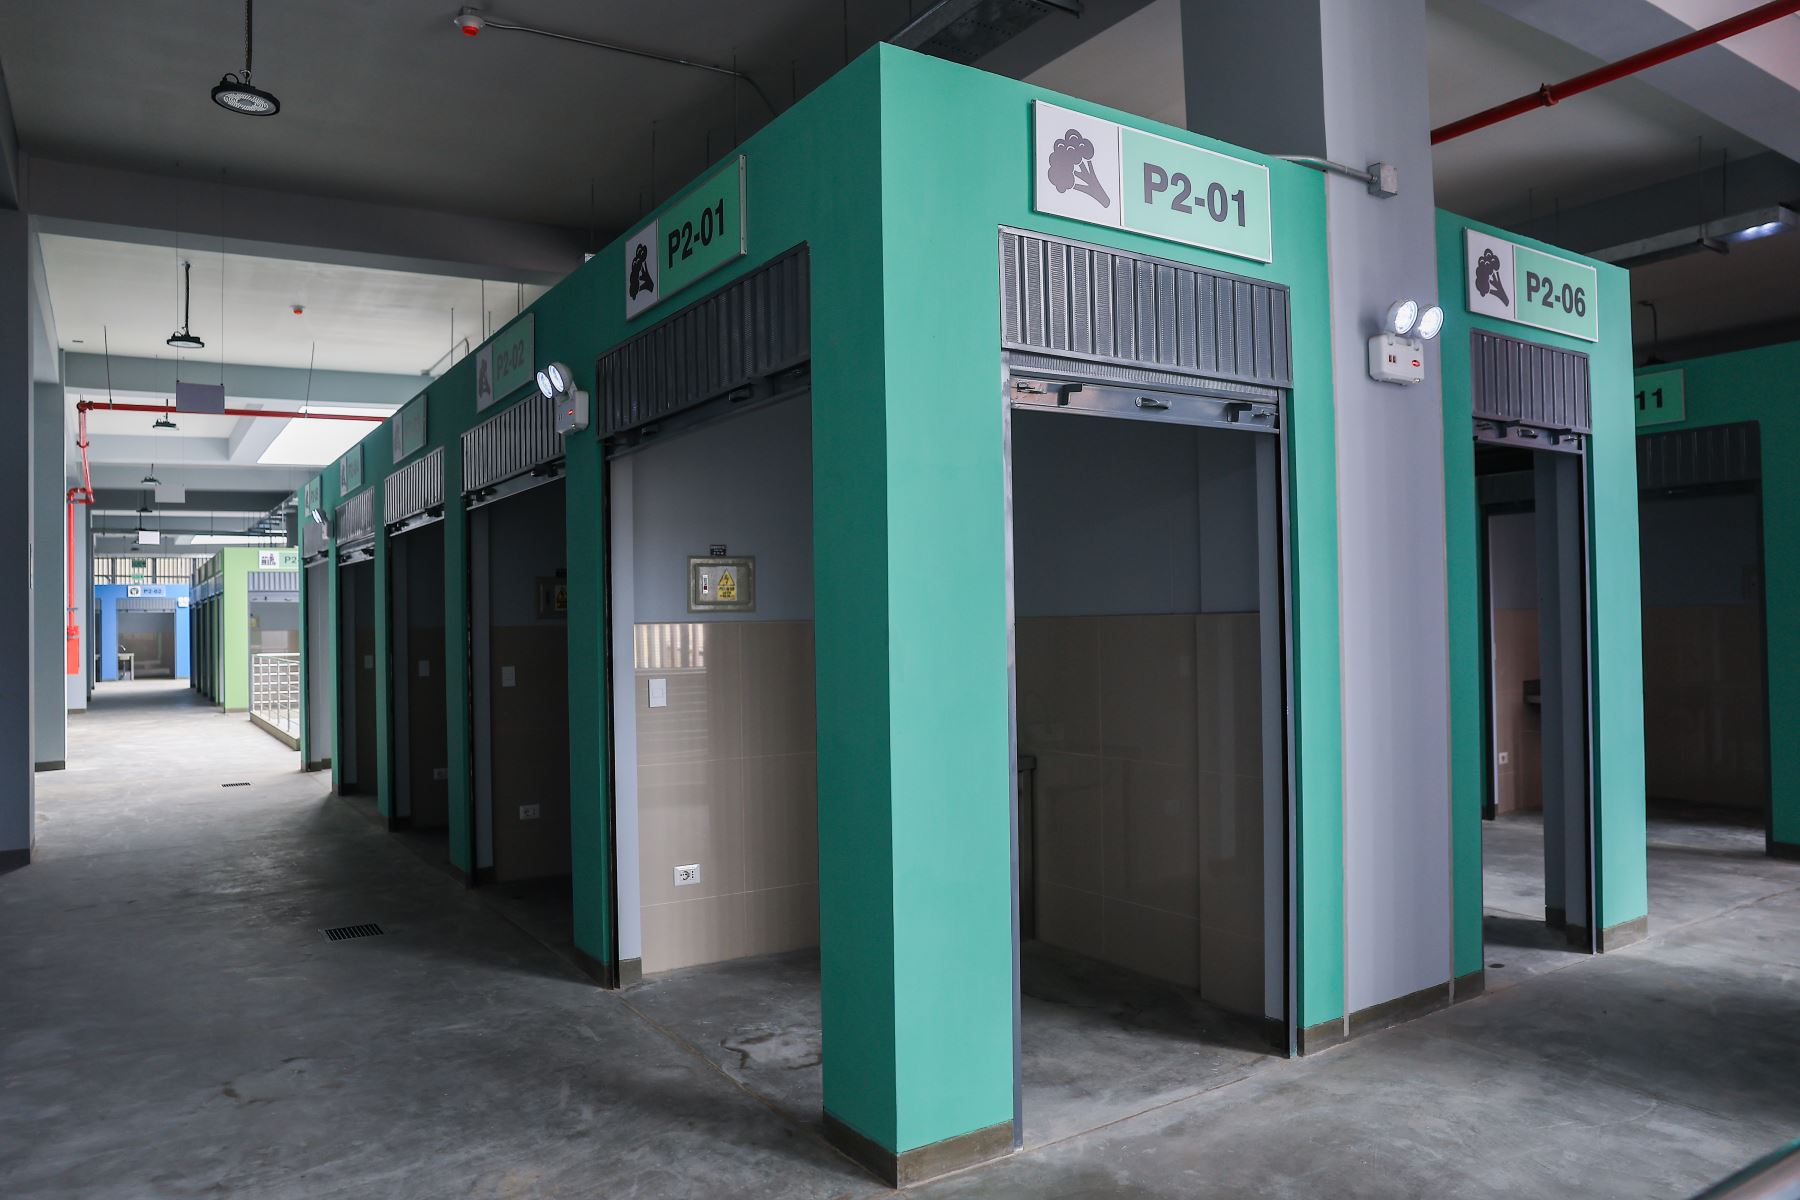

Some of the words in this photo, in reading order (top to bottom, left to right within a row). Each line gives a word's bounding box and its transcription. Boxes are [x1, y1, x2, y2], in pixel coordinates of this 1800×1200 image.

[1143, 162, 1246, 228] P2-01
[668, 197, 724, 270] P2-01
[1526, 270, 1587, 318] P2-06
[497, 340, 524, 379] P2-02
